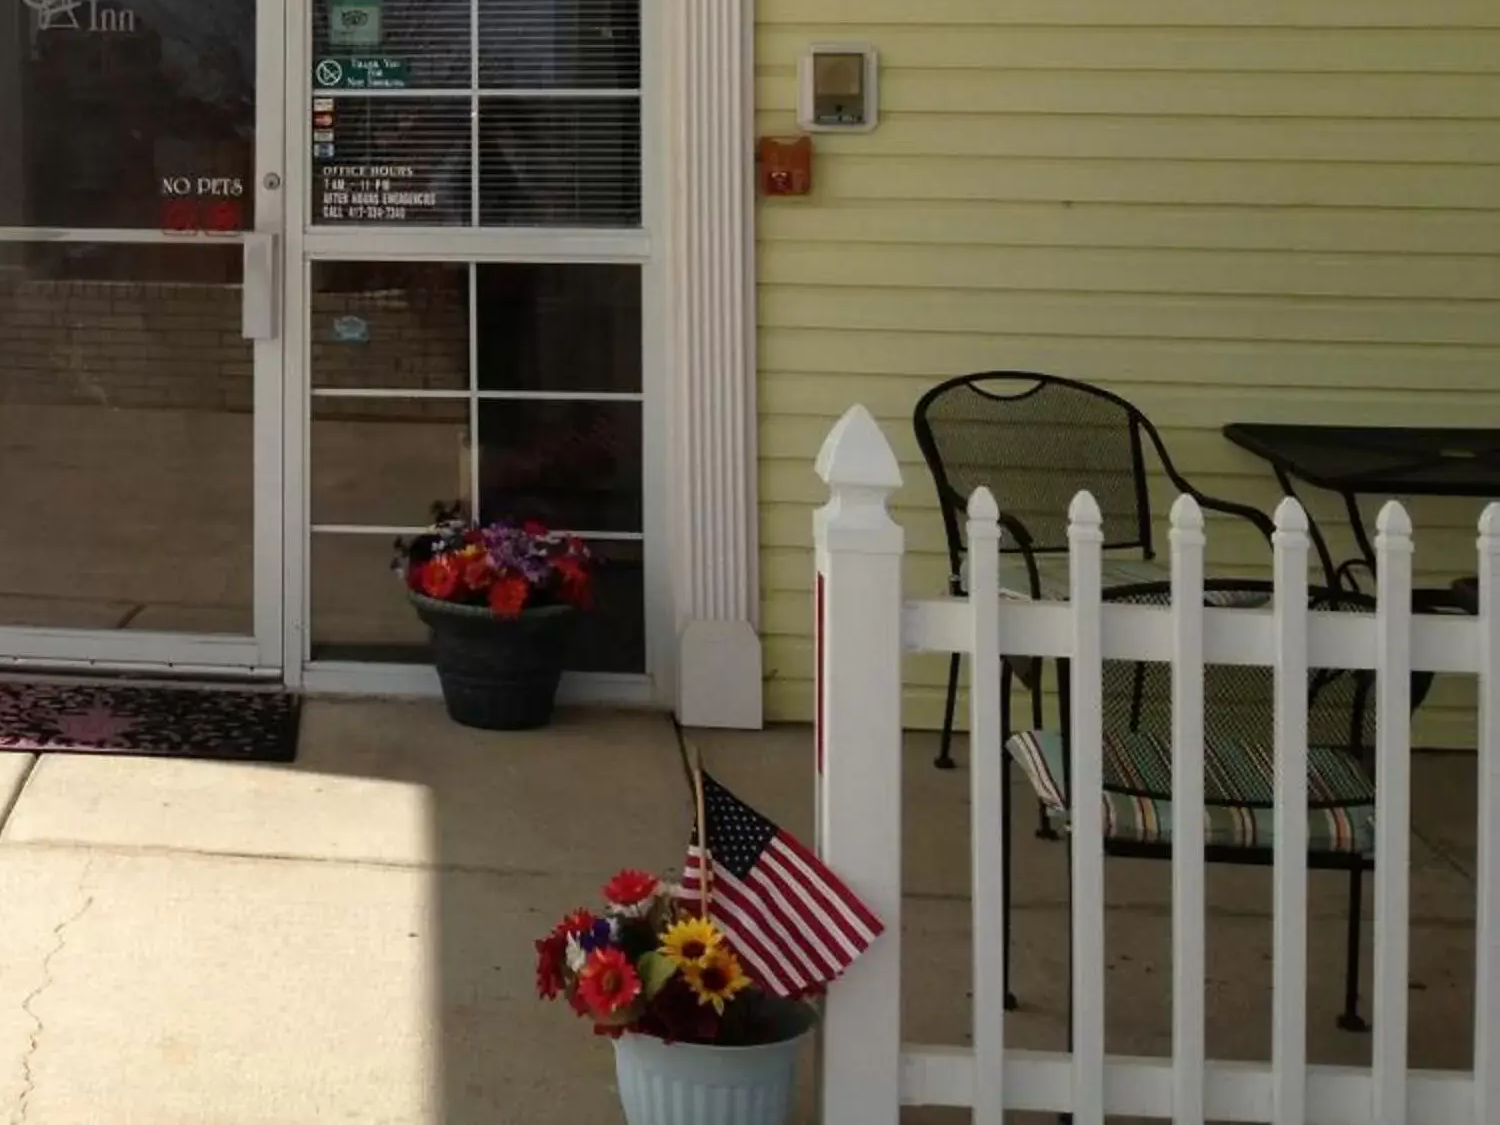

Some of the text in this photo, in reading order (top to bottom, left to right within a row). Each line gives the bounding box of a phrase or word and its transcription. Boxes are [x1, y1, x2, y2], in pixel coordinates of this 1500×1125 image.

[323, 166, 413, 177] OFFICE HOURS
[163, 177, 244, 196] NO PETS
